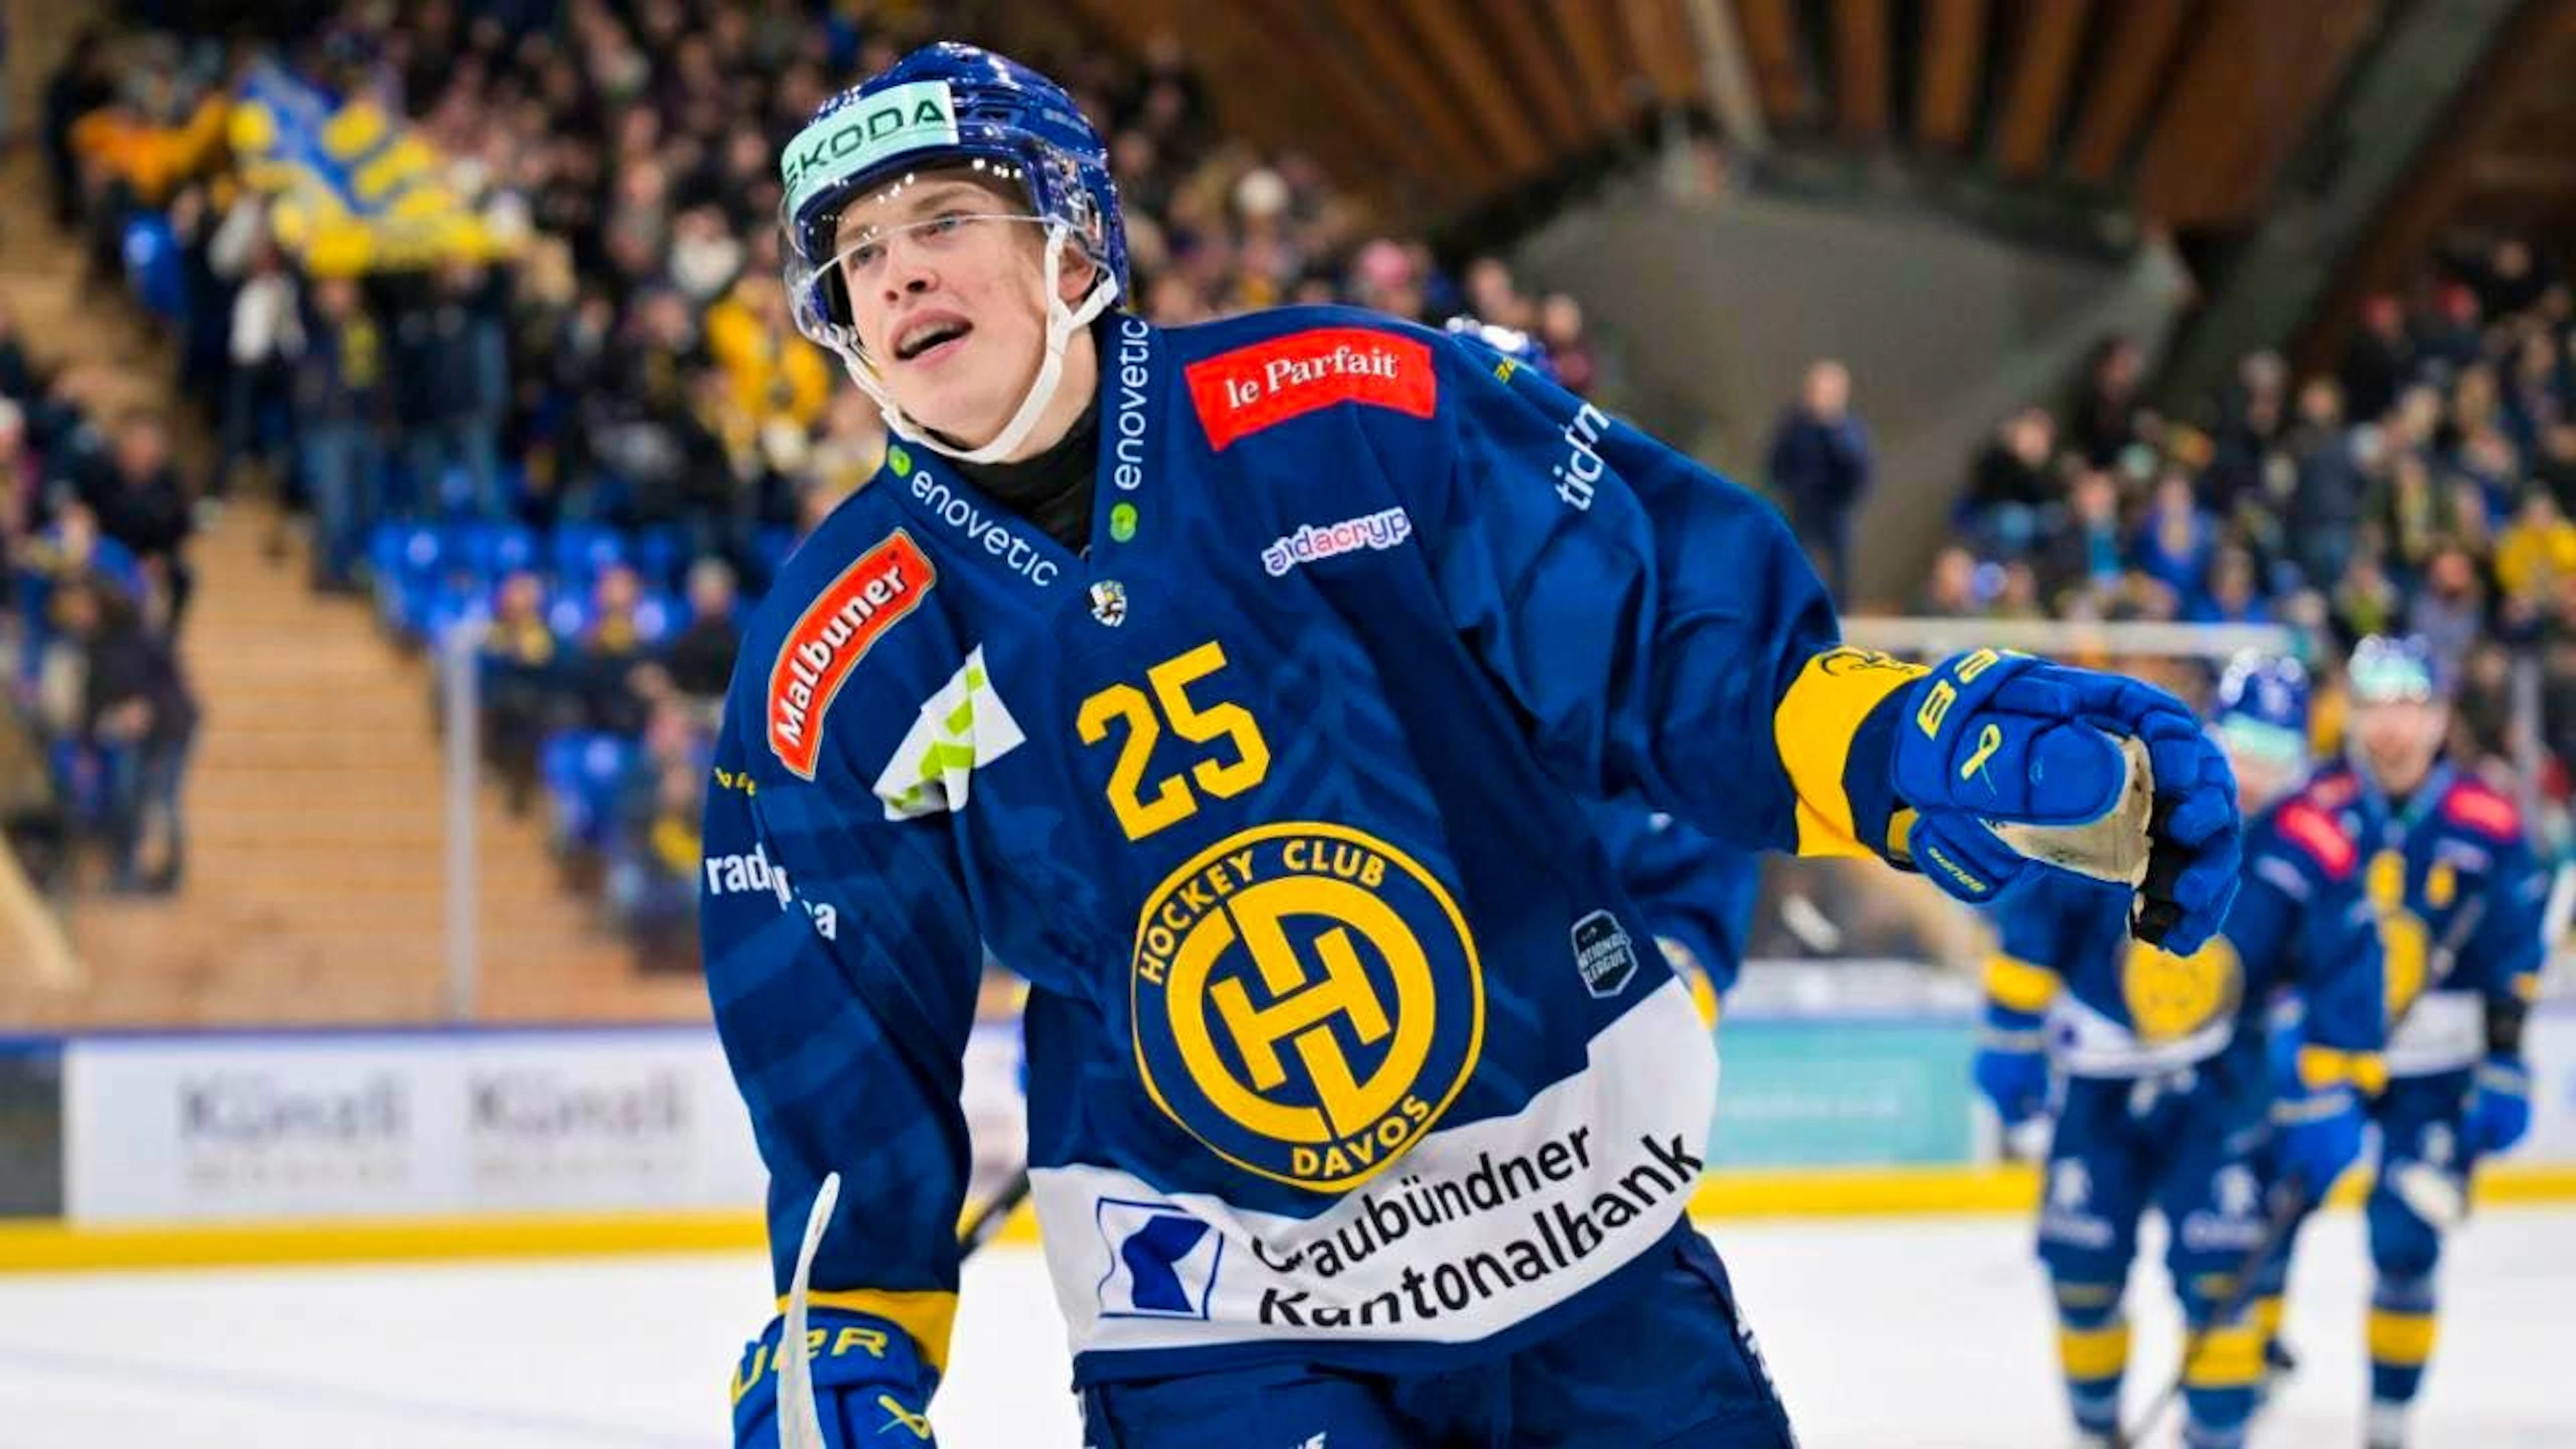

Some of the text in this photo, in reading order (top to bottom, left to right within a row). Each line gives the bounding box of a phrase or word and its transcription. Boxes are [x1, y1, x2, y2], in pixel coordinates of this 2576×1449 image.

[1114, 319, 1150, 490] enovetic
[1225, 346, 1399, 409] le Parfait
[911, 470, 1058, 586] enovetic
[775, 566, 908, 747] Malbuner
[1076, 640, 1271, 841] 25
[1138, 840, 1387, 985] HOCKEY CLUB
[1292, 1094, 1431, 1178] DAVOS
[1259, 1134, 1703, 1327] Kantonalbank
